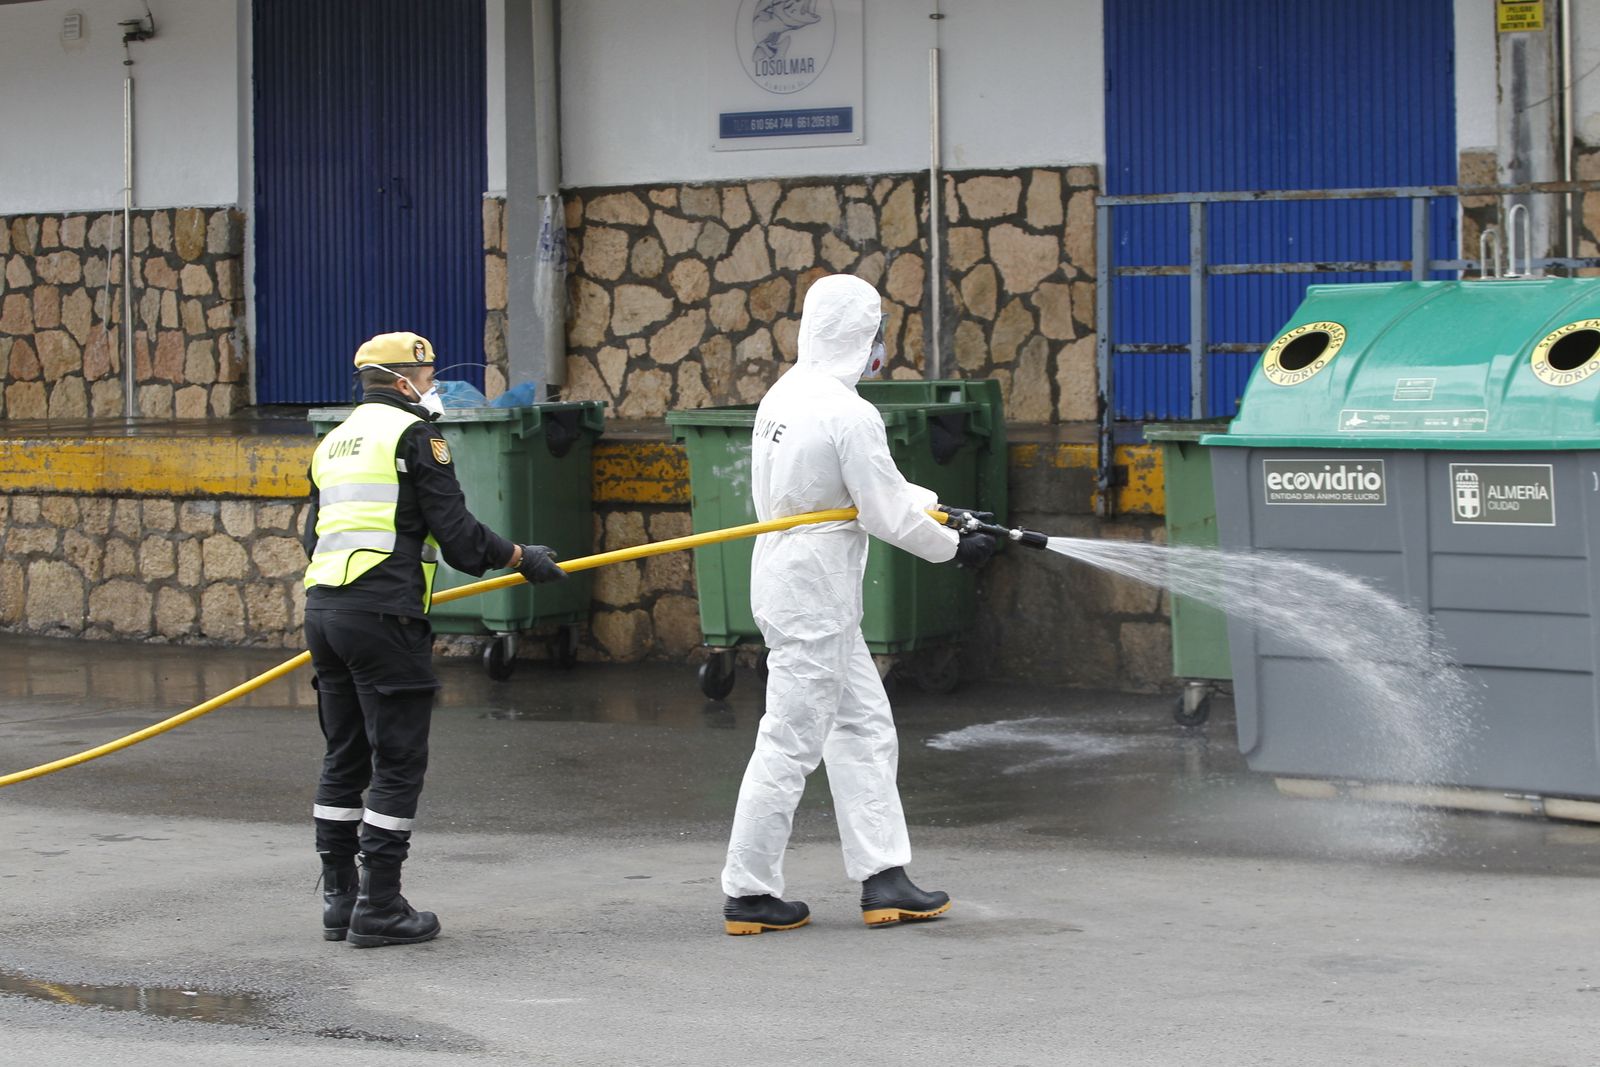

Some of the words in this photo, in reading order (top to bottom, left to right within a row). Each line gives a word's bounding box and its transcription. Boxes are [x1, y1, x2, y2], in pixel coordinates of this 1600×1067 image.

[755, 57, 815, 77] LOSOLMAR
[1271, 327, 1306, 352] SOLO
[1312, 322, 1344, 349] ENVASES
[1539, 323, 1577, 348] SOLO
[1266, 363, 1279, 378] DE
[1280, 360, 1325, 383] VIDRIO
[1534, 361, 1549, 376] DE
[1550, 360, 1600, 384] VIDRIO
[328, 436, 363, 459] UME
[1267, 464, 1382, 490] ecovidrio
[1270, 492, 1302, 500] ENTIDAD
[1303, 492, 1315, 500] SIN
[1488, 482, 1549, 500] ALMERÍA
[1488, 501, 1520, 511] CIUDAD
